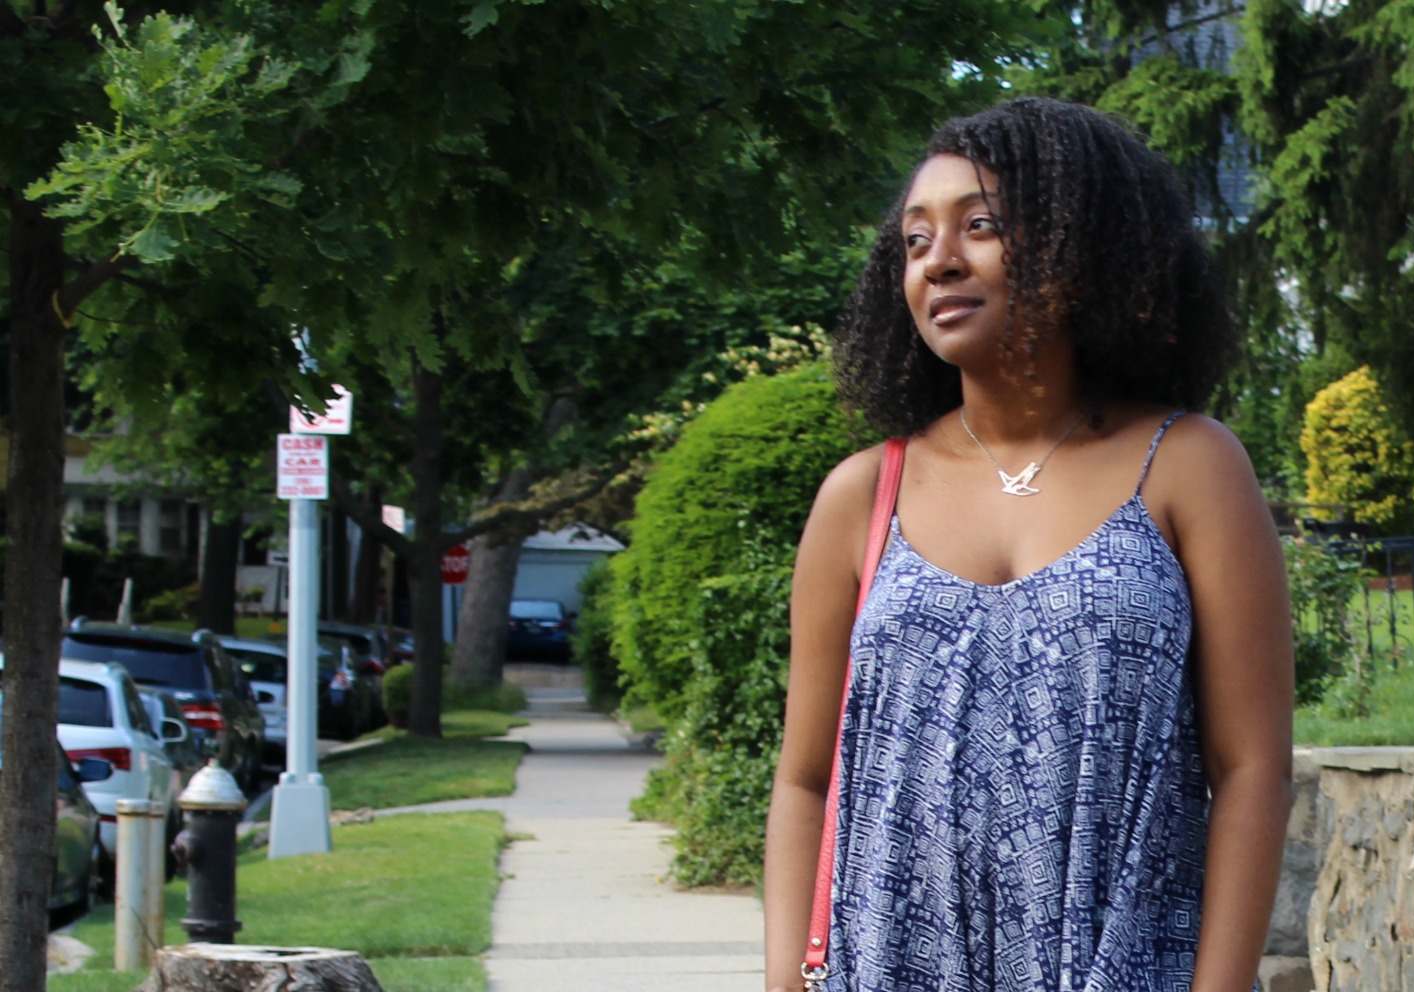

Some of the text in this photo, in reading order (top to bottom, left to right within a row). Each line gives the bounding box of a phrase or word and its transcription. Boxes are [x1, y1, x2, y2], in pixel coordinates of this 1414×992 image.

[282, 438, 323, 450] CASH
[284, 458, 321, 466] CAR
[440, 556, 468, 572] TOP
